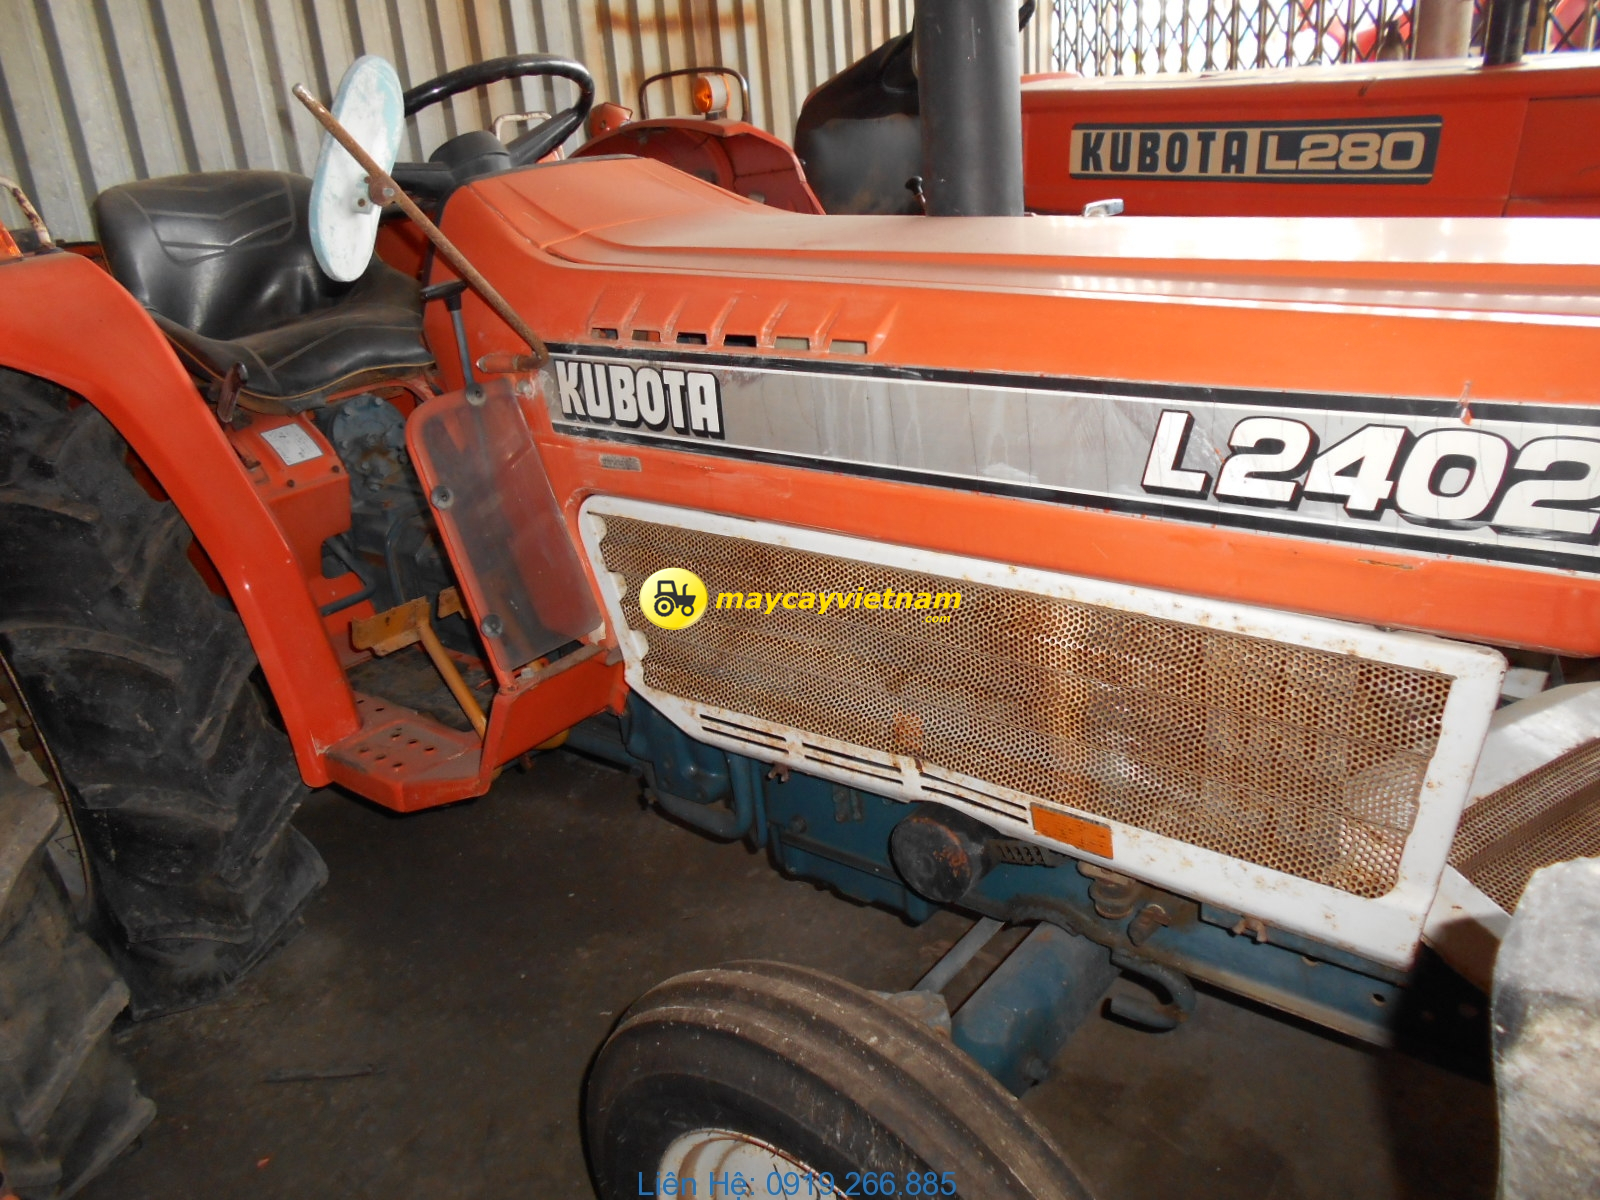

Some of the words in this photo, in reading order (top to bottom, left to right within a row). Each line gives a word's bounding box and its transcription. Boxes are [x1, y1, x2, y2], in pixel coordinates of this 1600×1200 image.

[1080, 130, 1249, 174] KUBOTA
[1264, 131, 1426, 171] L280
[554, 359, 725, 440] KUBOTA
[1141, 408, 1600, 545] L2402
